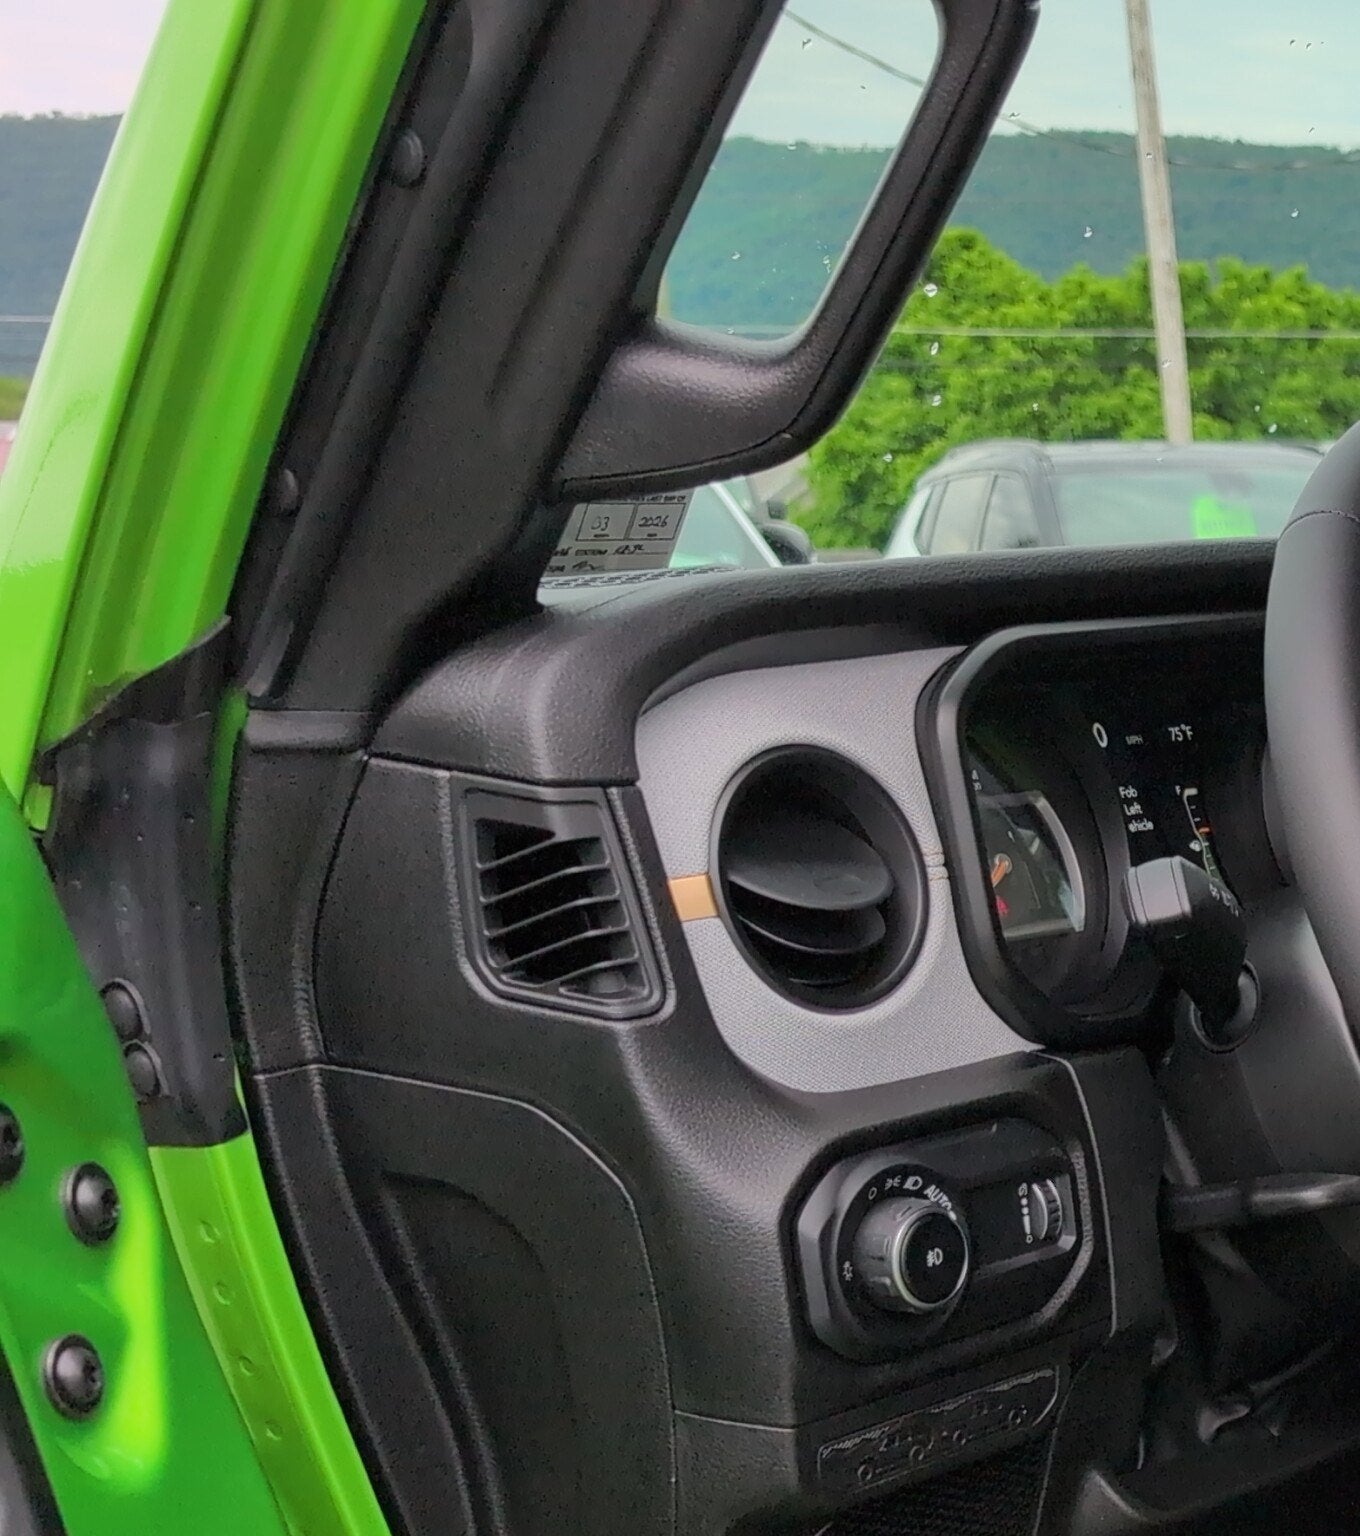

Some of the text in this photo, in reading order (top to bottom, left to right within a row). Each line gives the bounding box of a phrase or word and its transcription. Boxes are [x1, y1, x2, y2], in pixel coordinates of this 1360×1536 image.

[1092, 721, 1108, 748] 0
[1119, 785, 1138, 798] Fob
[1123, 801, 1143, 816] Left
[1128, 817, 1154, 833] ehicle
[923, 1182, 953, 1212] AUTO
